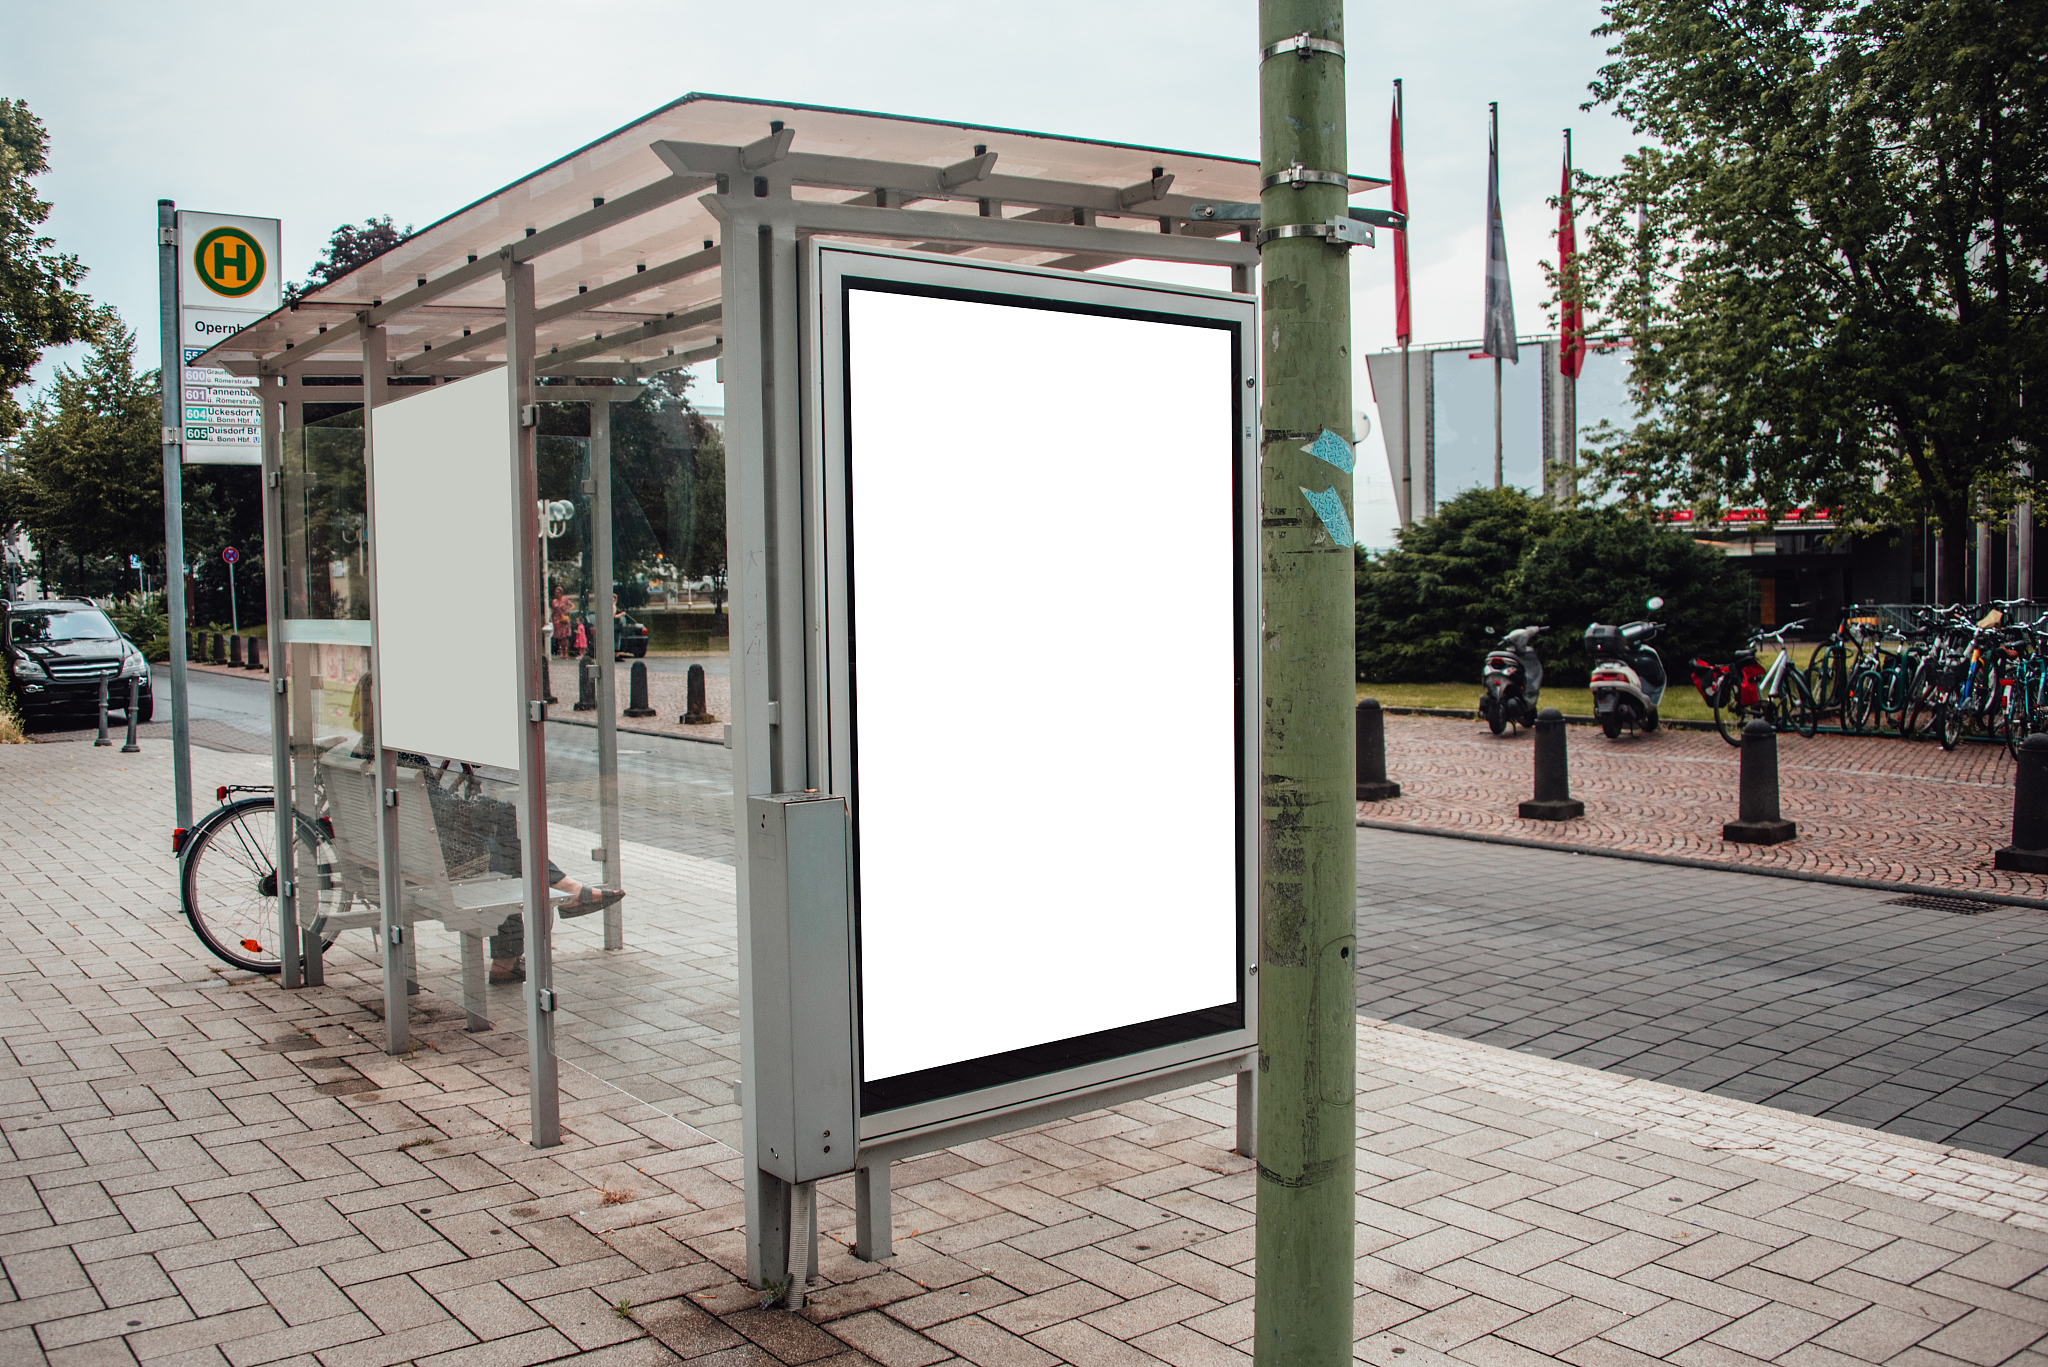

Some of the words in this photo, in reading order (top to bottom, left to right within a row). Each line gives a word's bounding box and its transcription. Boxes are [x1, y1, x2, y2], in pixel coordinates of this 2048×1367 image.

[214, 242, 246, 281] H
[186, 370, 205, 380] 600
[214, 377, 253, 385] Römerstraße
[186, 390, 205, 400] 601
[207, 387, 255, 397] Tannenbu
[216, 397, 260, 405] Römerstraße
[186, 409, 206, 419] 604
[187, 429, 207, 439] 605
[208, 426, 245, 435] Duisdorf
[248, 427, 259, 435] Bf.
